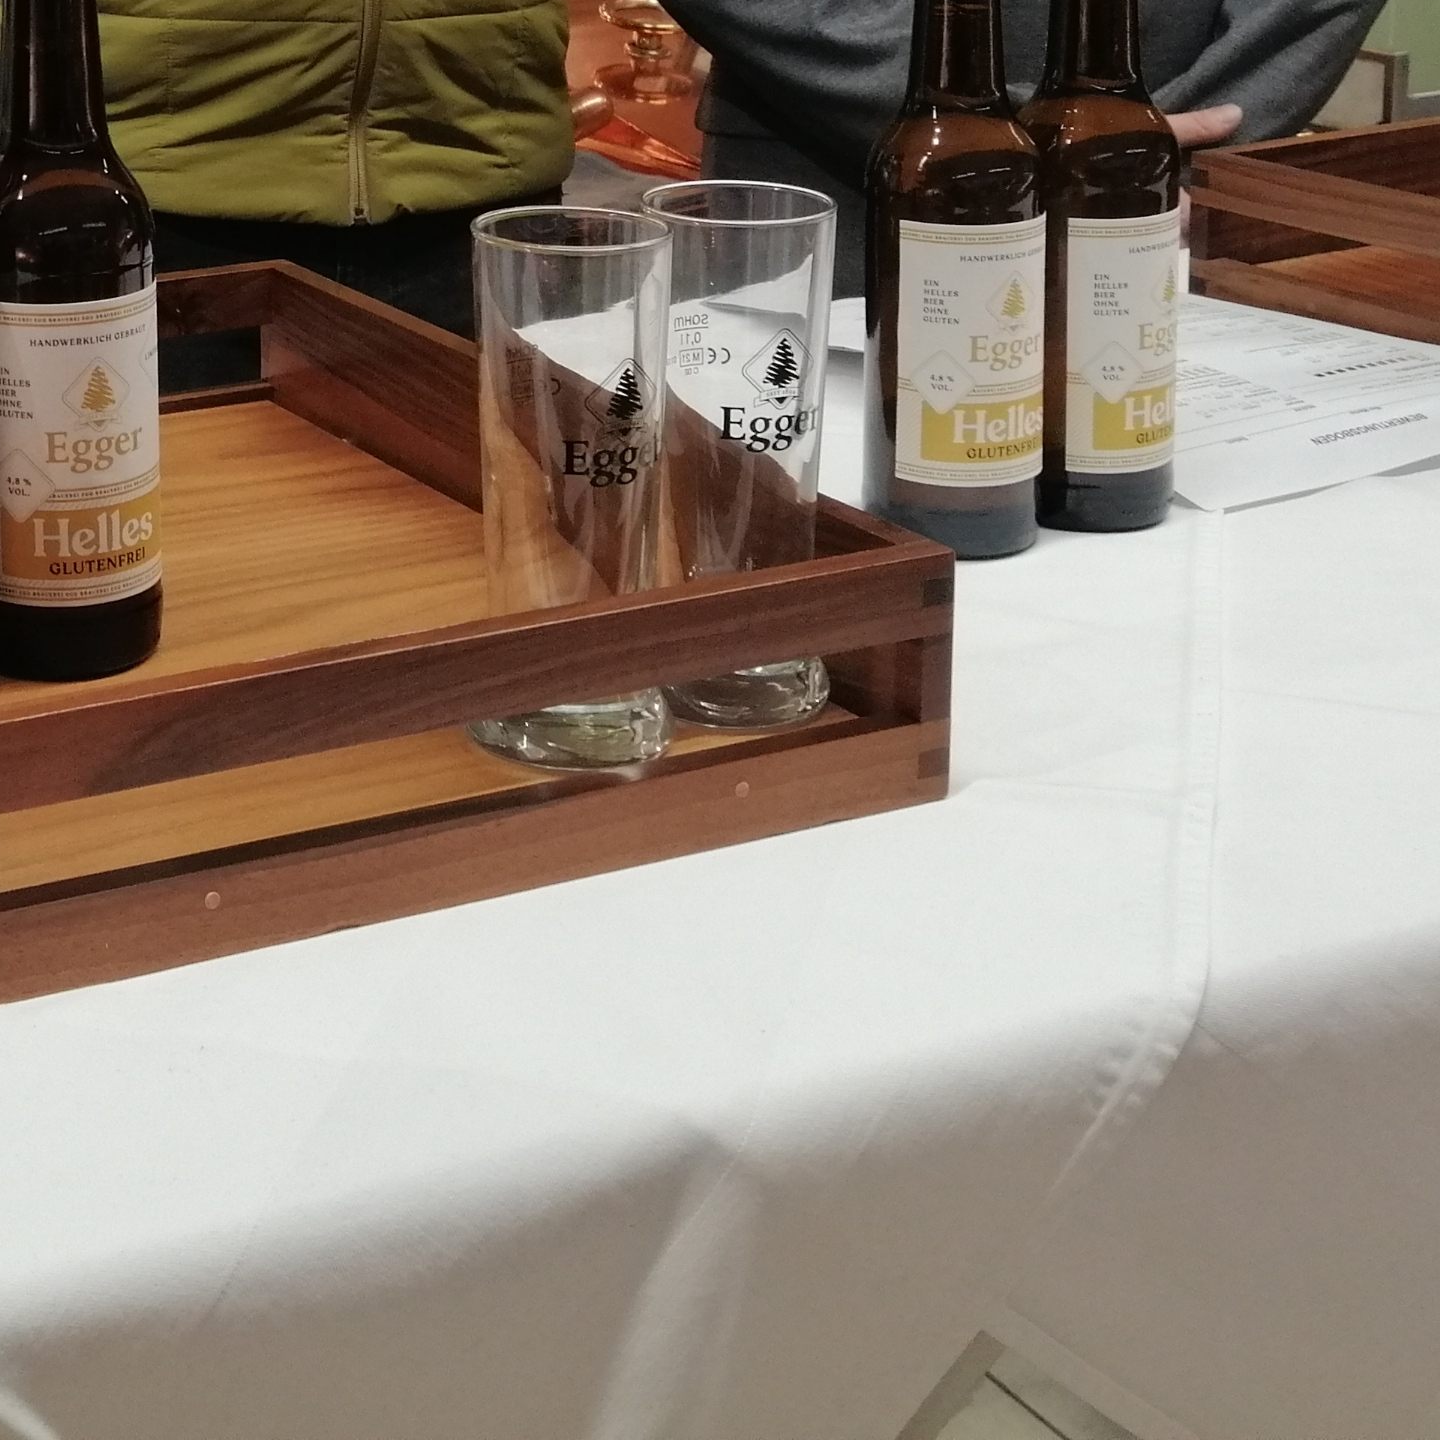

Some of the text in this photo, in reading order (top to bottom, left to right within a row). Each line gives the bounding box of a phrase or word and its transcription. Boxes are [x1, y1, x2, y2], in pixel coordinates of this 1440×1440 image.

[924, 279, 939, 287] EIN
[924, 289, 959, 297] HELLES
[923, 298, 944, 306] BIER
[923, 307, 949, 315] OHNE
[923, 317, 959, 325] GLUTEN
[29, 324, 146, 348] HANDWERKLICH GEBRAUT
[968, 334, 1040, 371] Egger
[953, 403, 1042, 444] Helles
[1311, 412, 1428, 446] BEWERTUNGSBOGEN
[44, 427, 142, 474] Egger
[33, 509, 153, 558] Helles
[49, 547, 145, 576] GLUTENFREI
